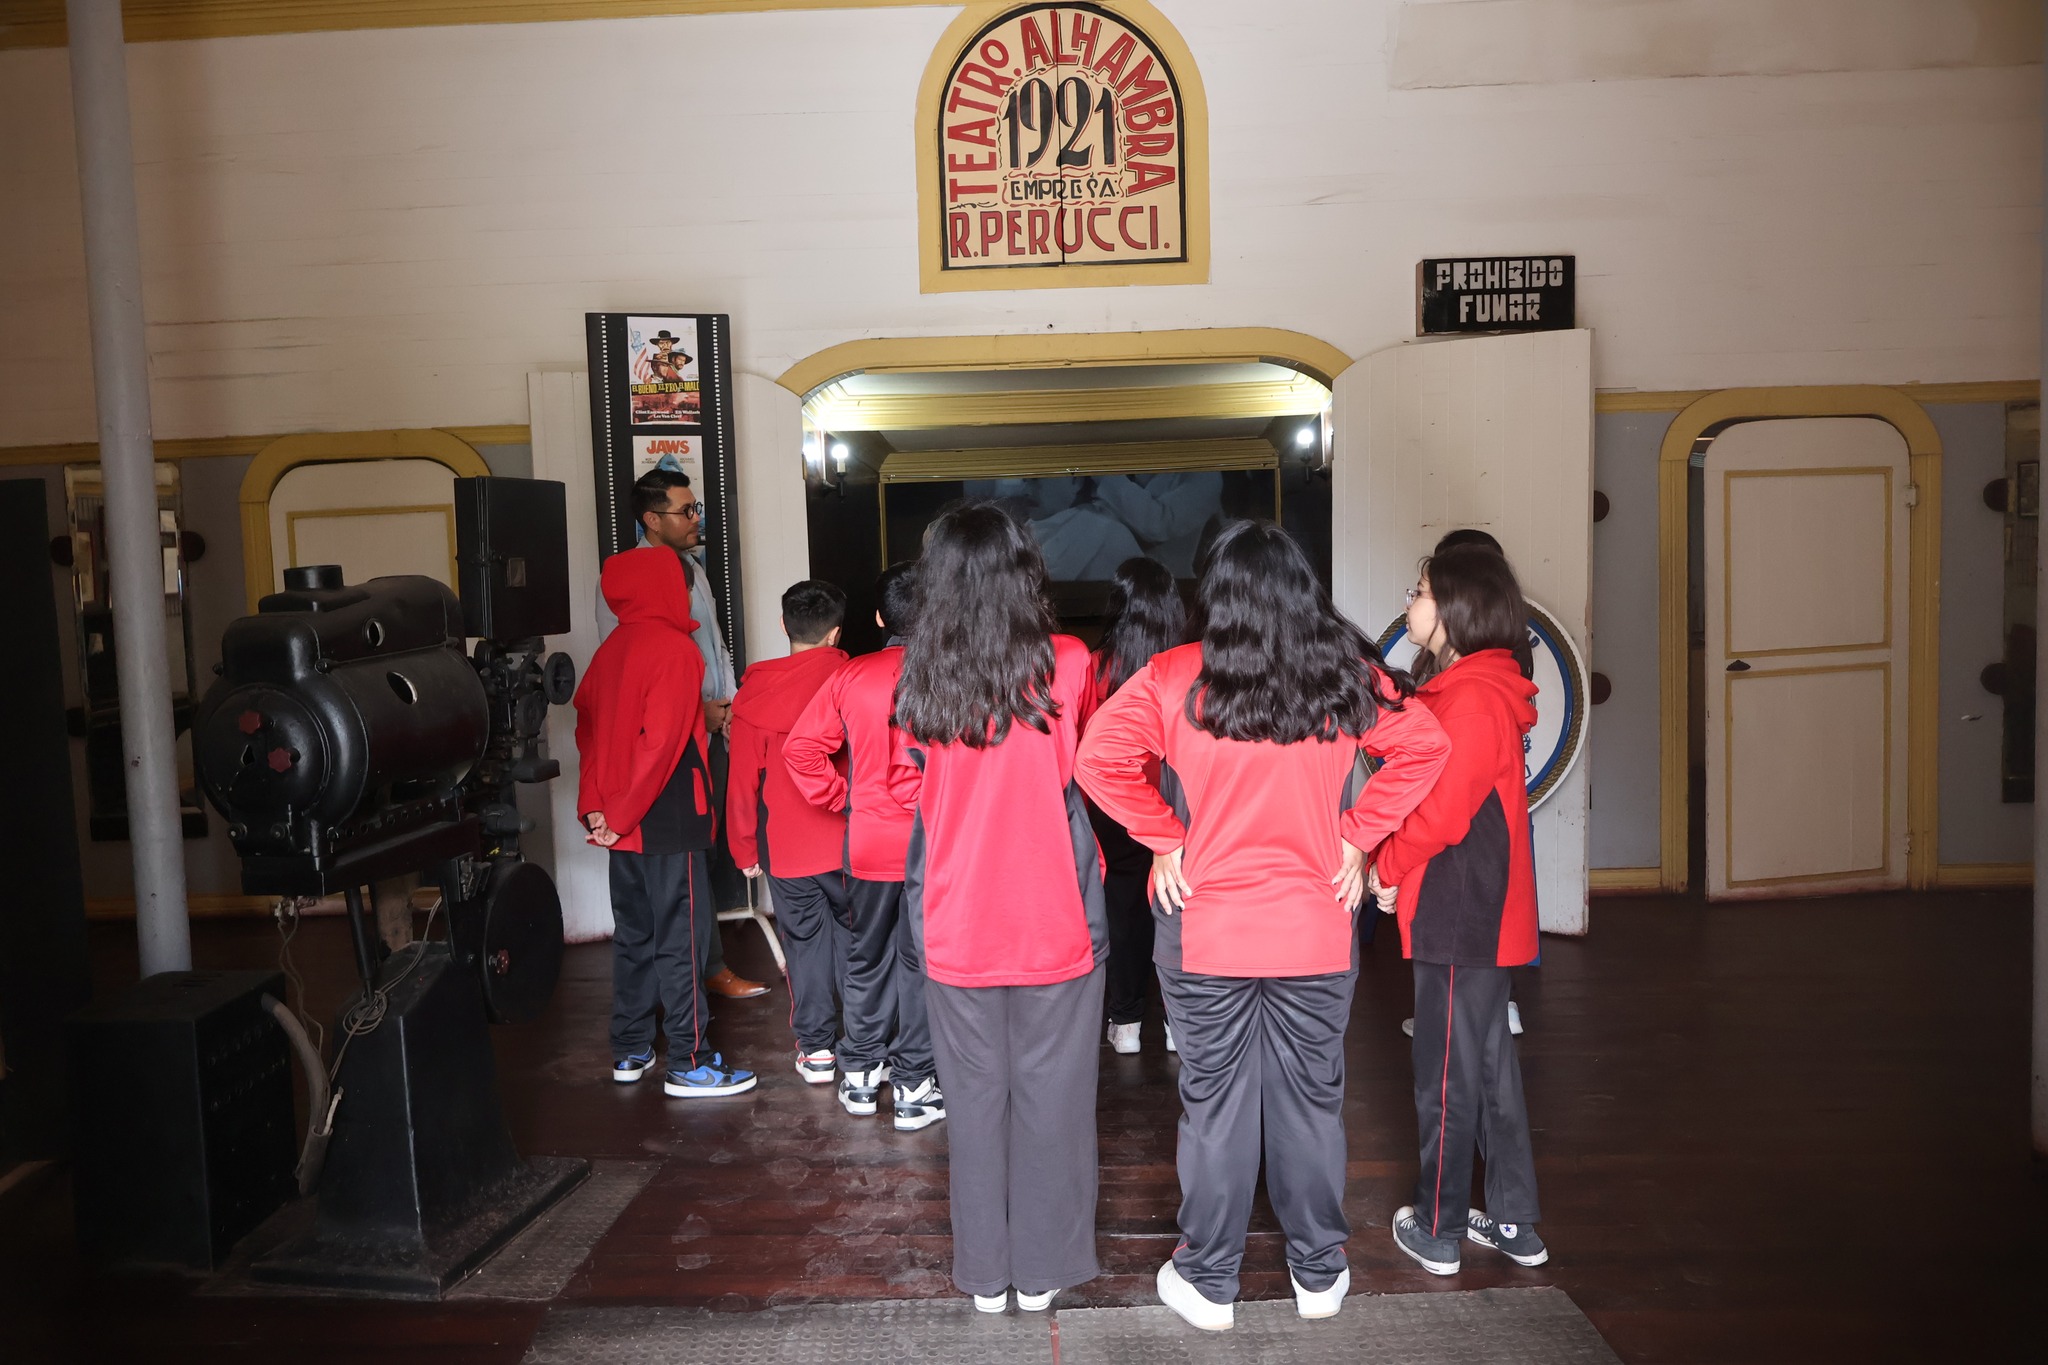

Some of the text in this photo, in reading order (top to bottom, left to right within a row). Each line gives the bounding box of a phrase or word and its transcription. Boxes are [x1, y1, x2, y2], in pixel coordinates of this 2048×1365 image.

[1019, 10, 1176, 198] ALHAMBRA
[1002, 76, 1117, 170] 1921
[1436, 259, 1563, 291] PROHIBIDO
[632, 385, 638, 393] EL
[665, 382, 678, 392] FEO
[646, 440, 690, 454] JAWS
